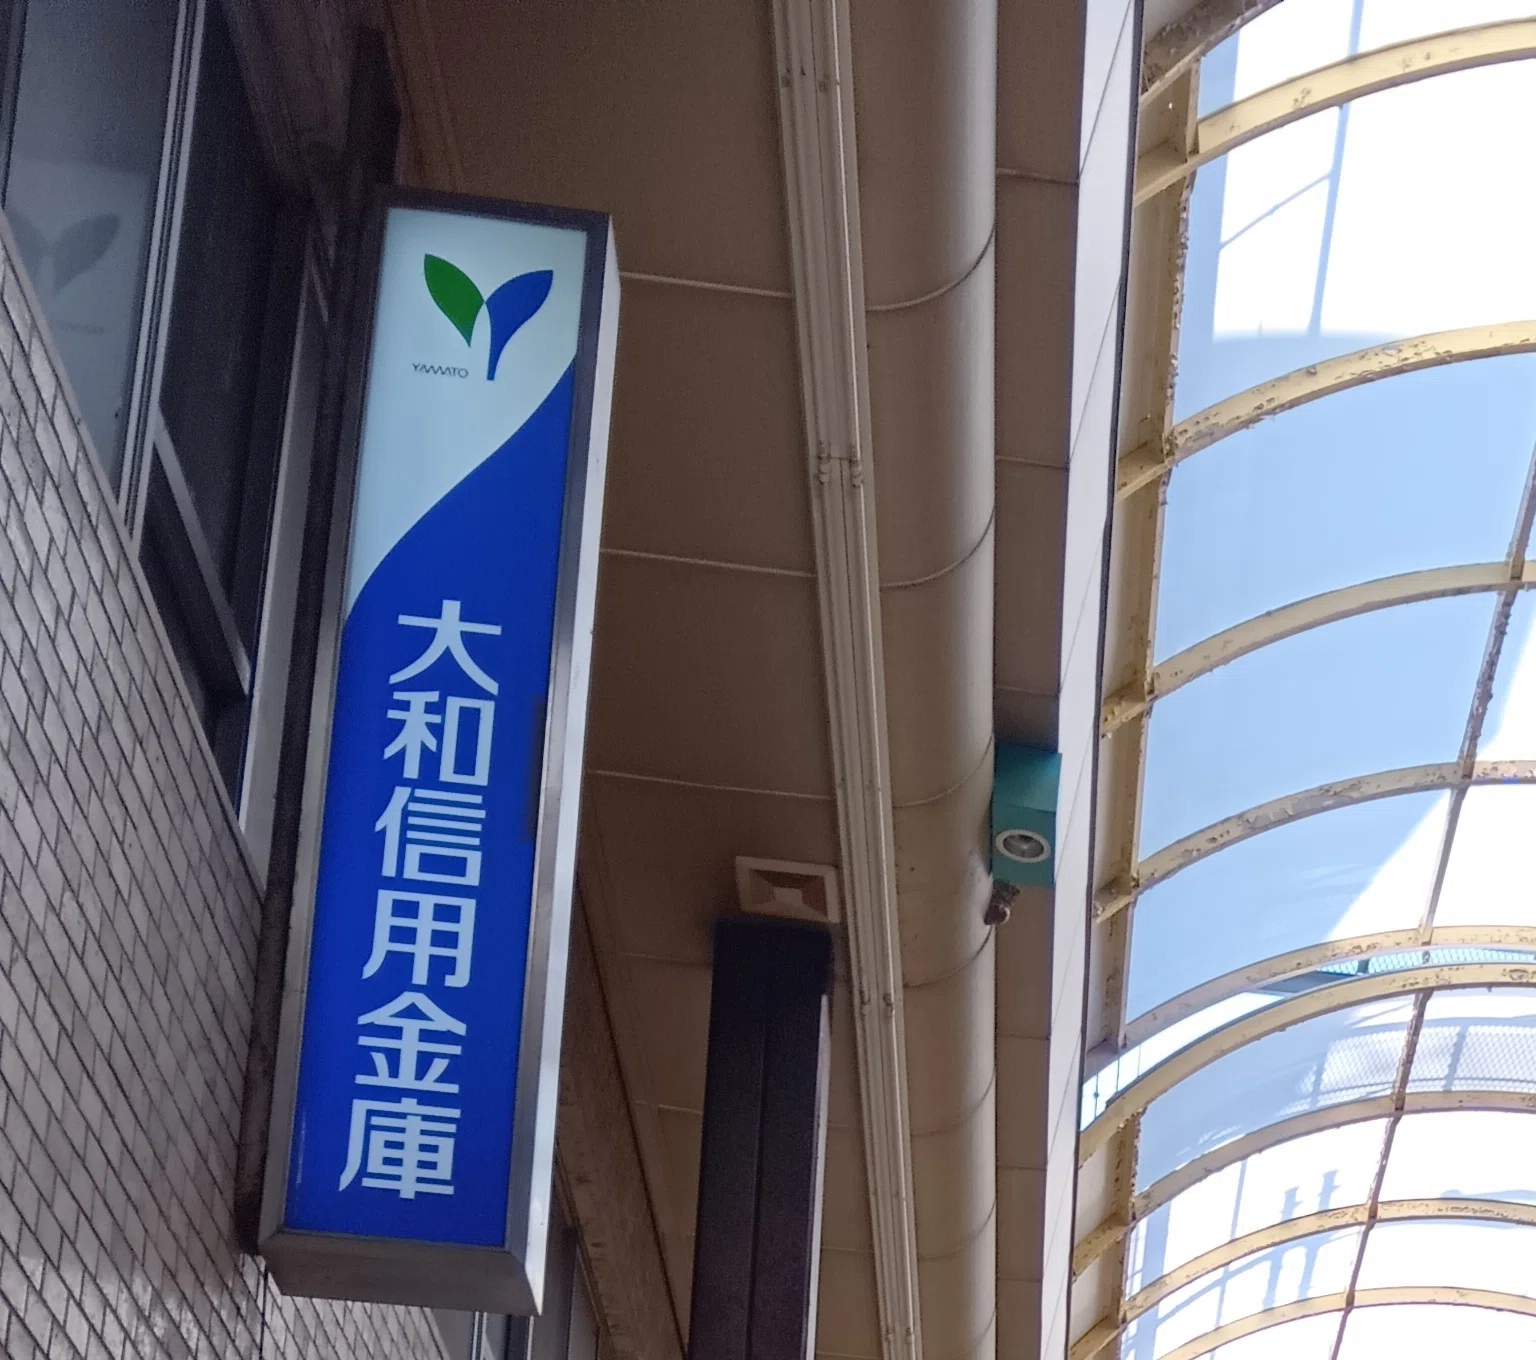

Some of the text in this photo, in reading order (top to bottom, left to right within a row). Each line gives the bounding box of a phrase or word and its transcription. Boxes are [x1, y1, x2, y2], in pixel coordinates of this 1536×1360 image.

[412, 362, 469, 379] YAMATO
[338, 599, 502, 1199] 大和信用金庫
